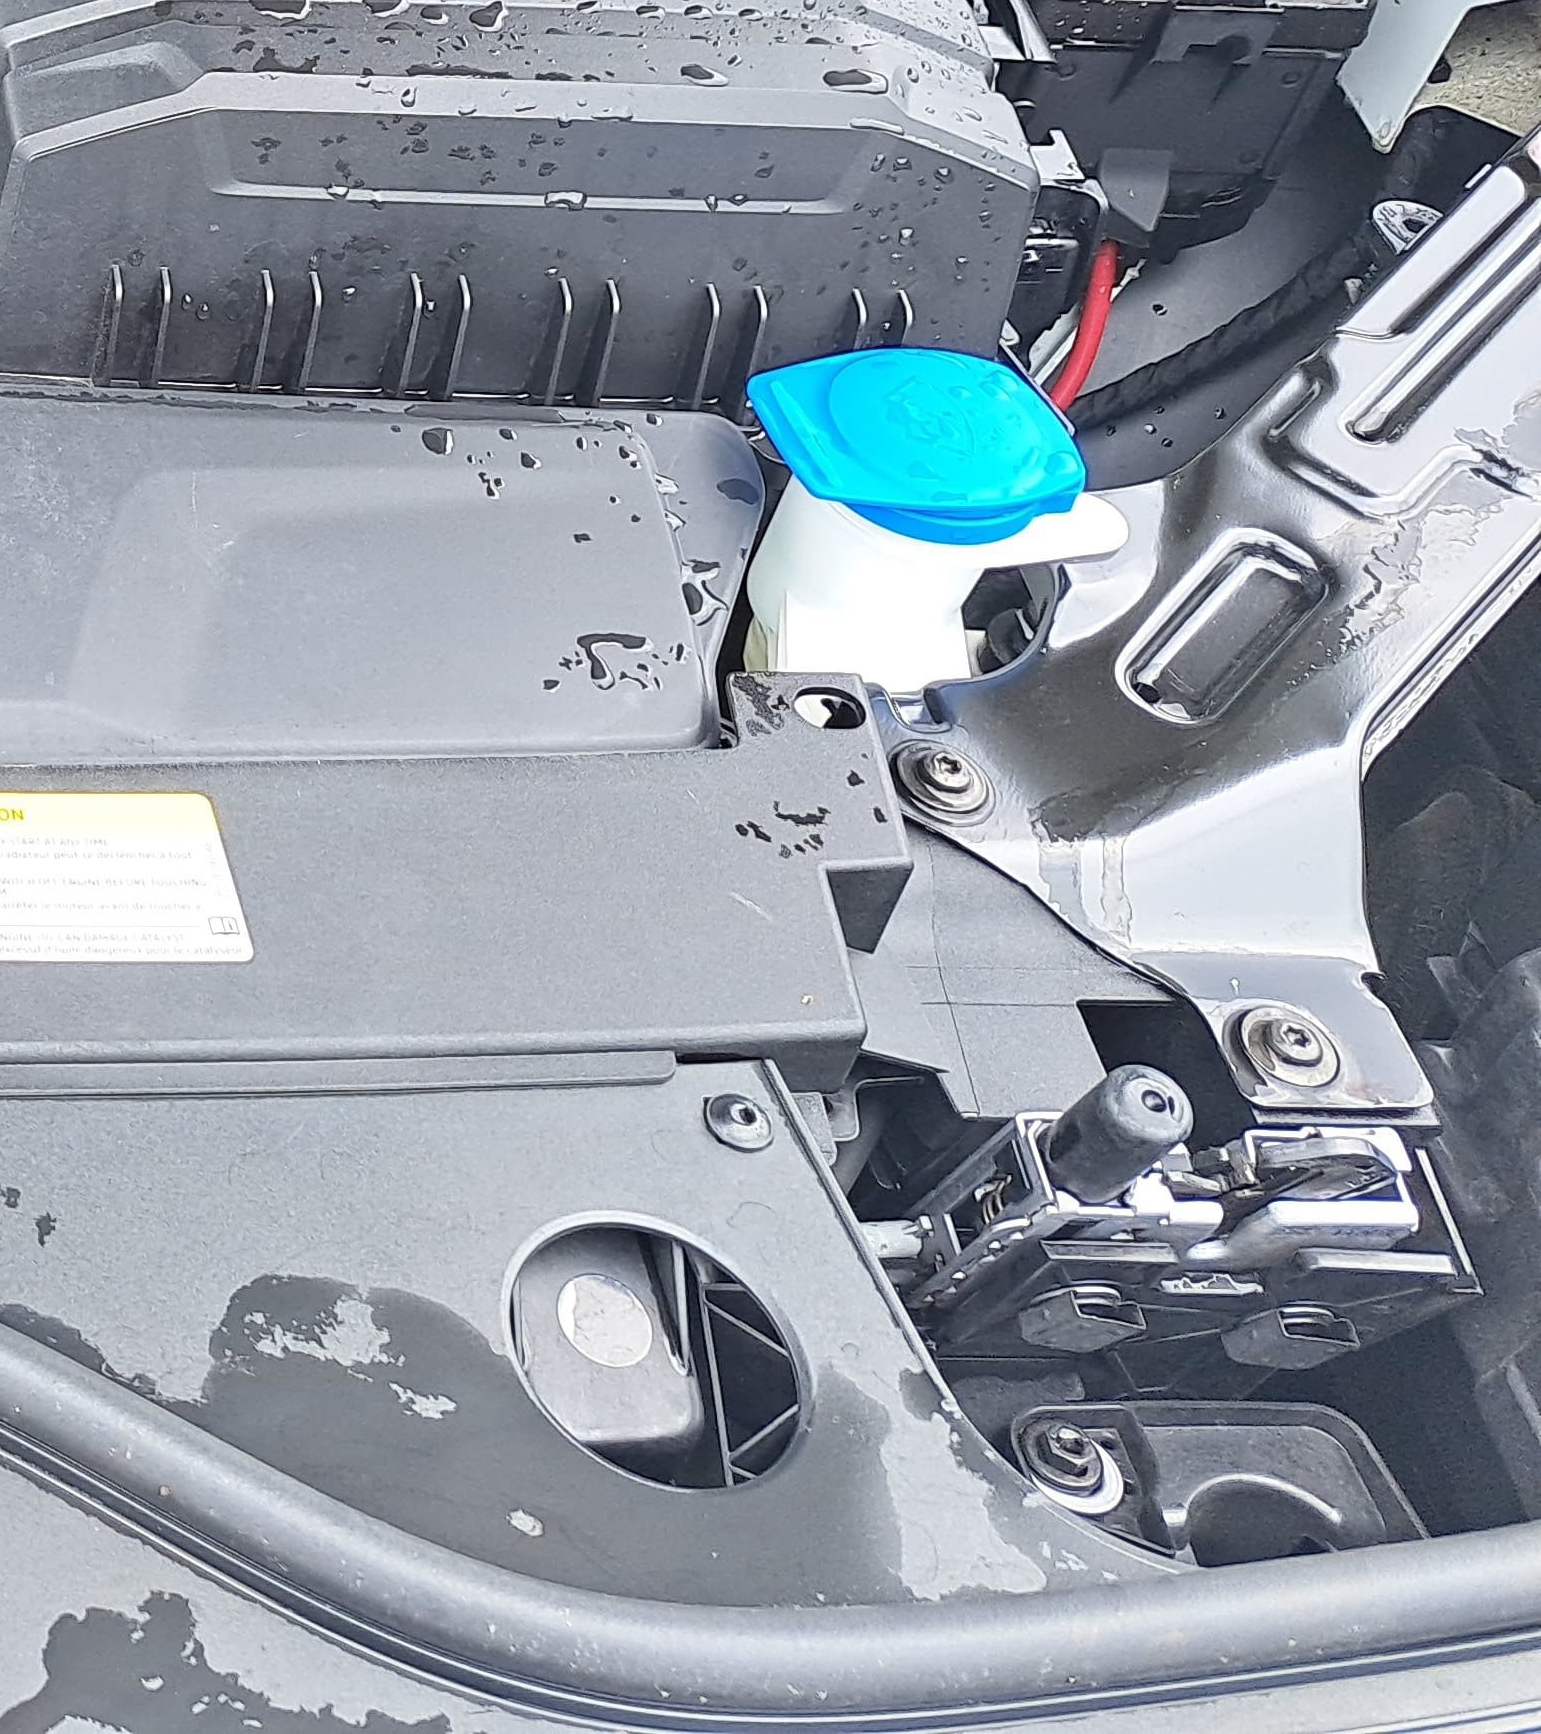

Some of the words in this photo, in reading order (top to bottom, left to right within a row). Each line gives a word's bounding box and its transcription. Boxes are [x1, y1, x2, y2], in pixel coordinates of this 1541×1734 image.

[59, 838, 80, 846] ANY
[84, 838, 109, 846] TIME
[1, 851, 49, 859] radiateur
[53, 851, 78, 860] peut
[168, 851, 192, 859] tout
[61, 878, 100, 886] ENGINE
[105, 878, 146, 887] BEFORE
[54, 902, 94, 910] moteur
[98, 902, 129, 910] avant
[132, 901, 144, 910] de
[150, 902, 191, 910] toucher
[57, 933, 80, 942] CAN
[84, 933, 128, 942] DAMAGE
[134, 934, 184, 942] CATALYST
[85, 946, 142, 956] dangereux
[145, 946, 170, 955] pour
[187, 946, 243, 955] catalyseur
